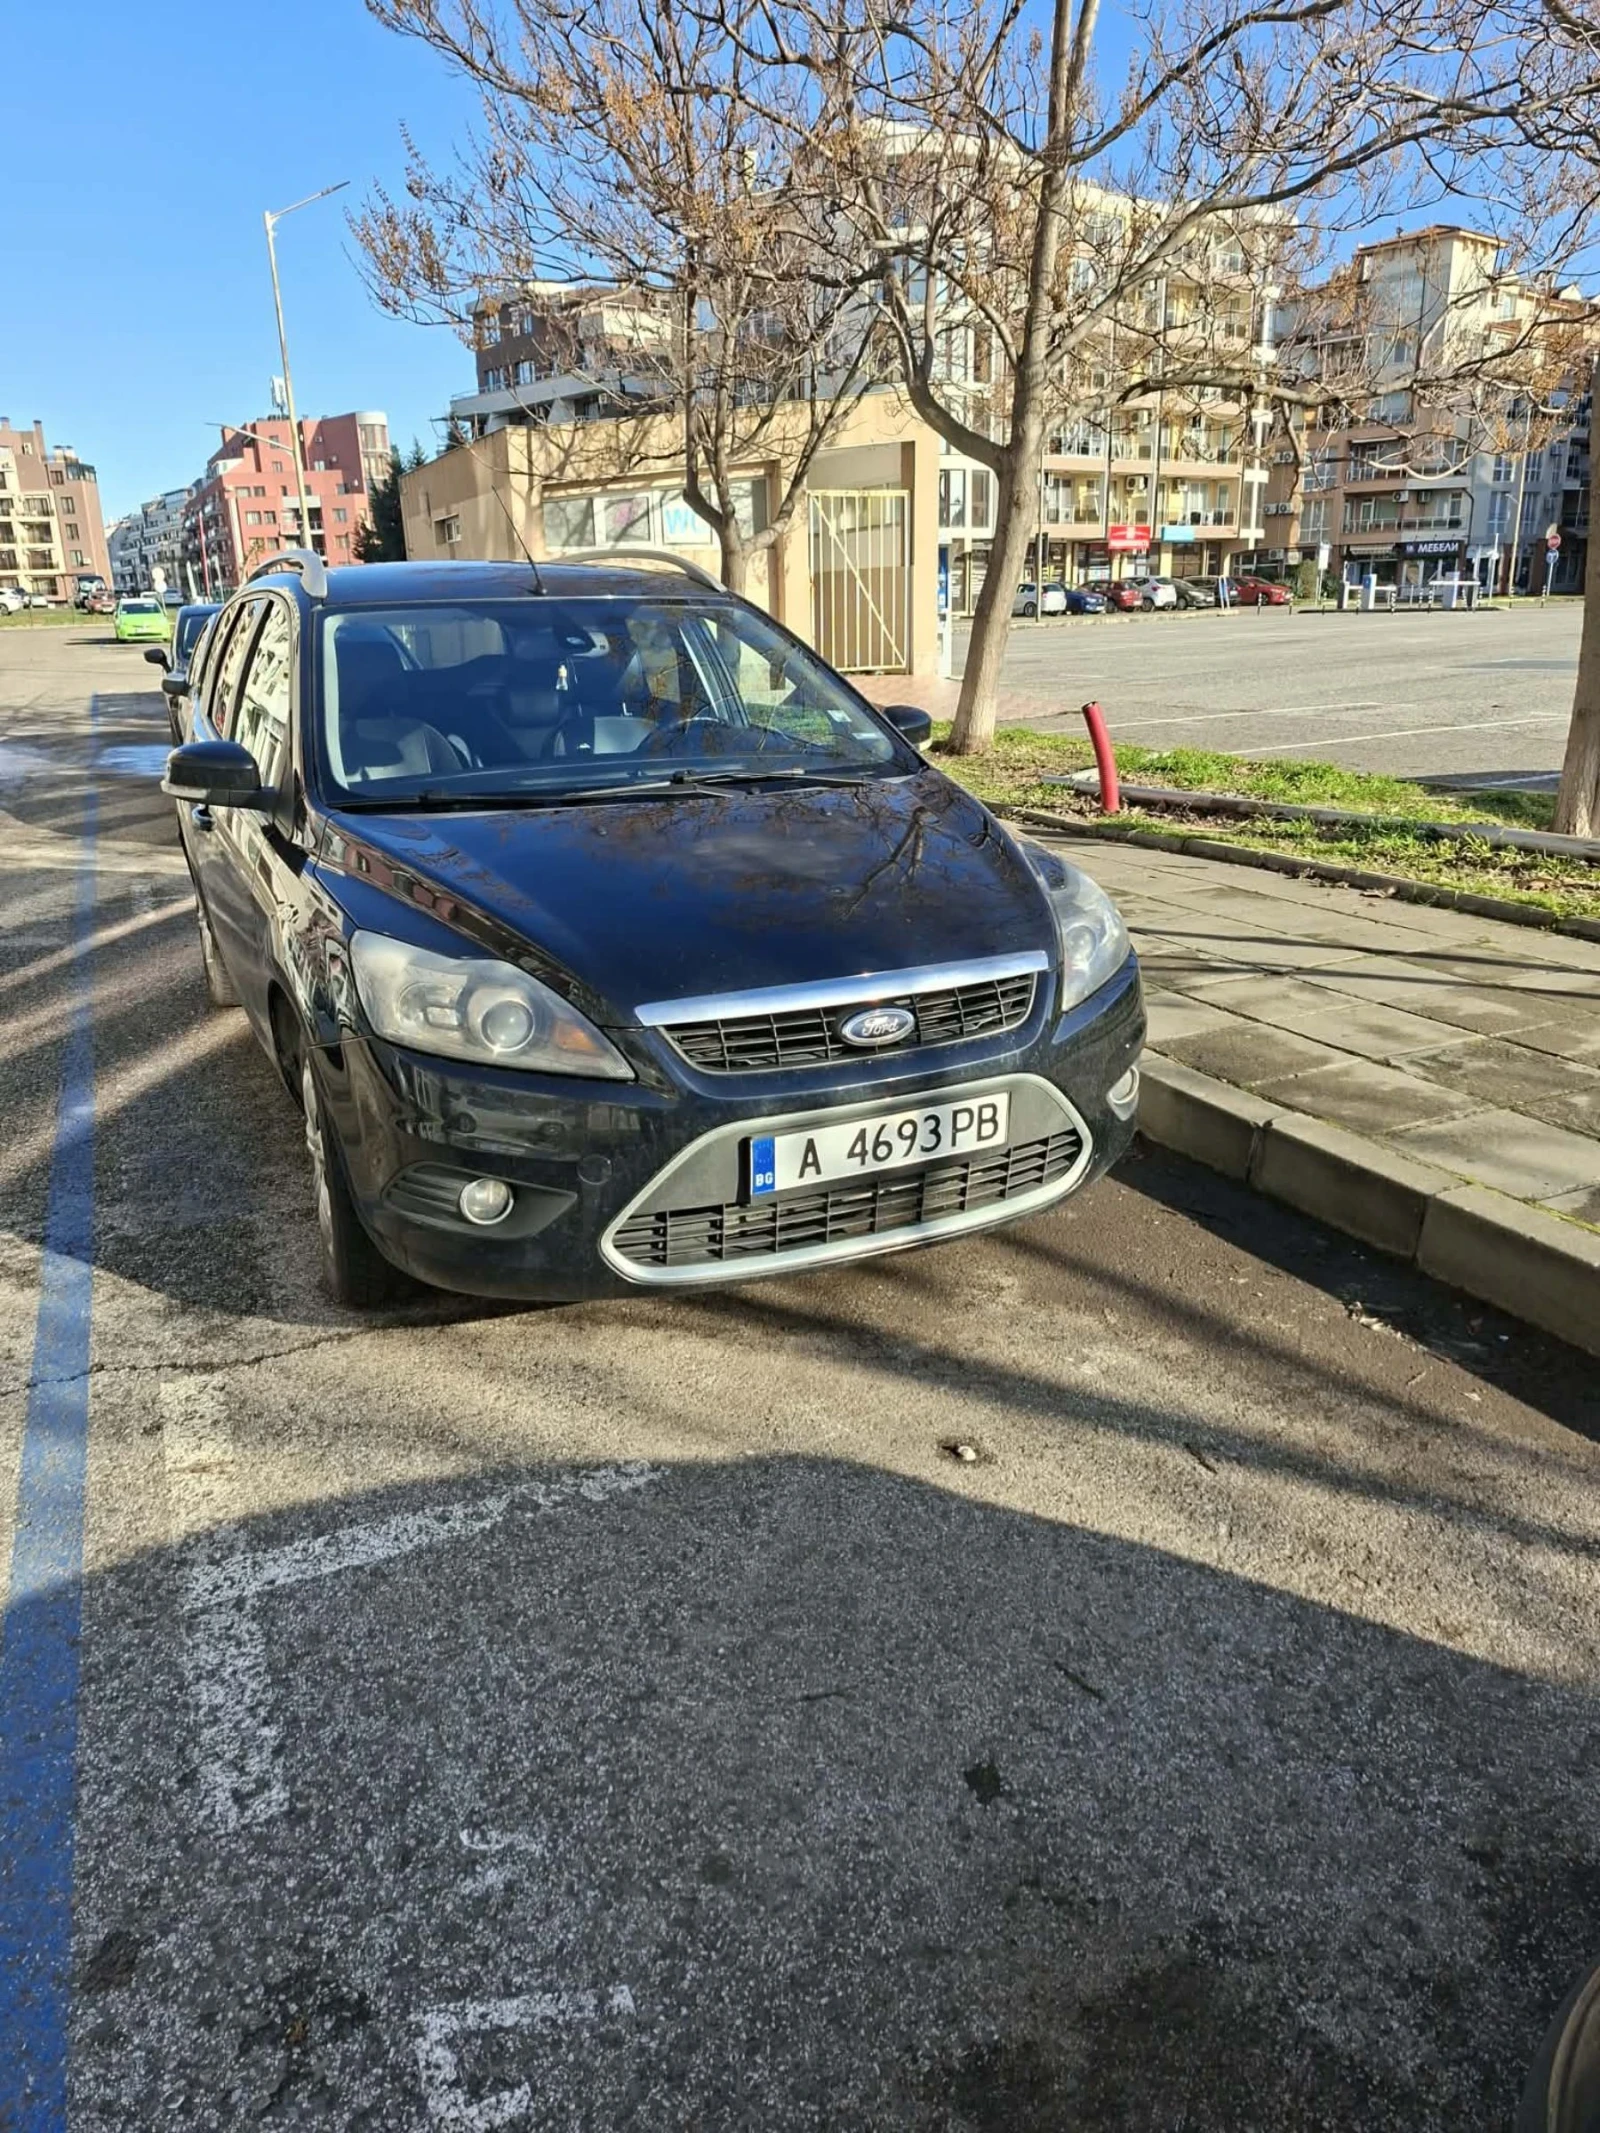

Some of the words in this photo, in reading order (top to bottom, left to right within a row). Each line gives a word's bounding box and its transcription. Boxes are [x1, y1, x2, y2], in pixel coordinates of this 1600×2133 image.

[1417, 542, 1459, 553] МЕБЕЛИ
[861, 1016, 899, 1037] Ford
[798, 1138, 822, 1179] A
[847, 1114, 942, 1166] 4693
[951, 1102, 999, 1147] PB
[754, 1173, 774, 1187] BG
